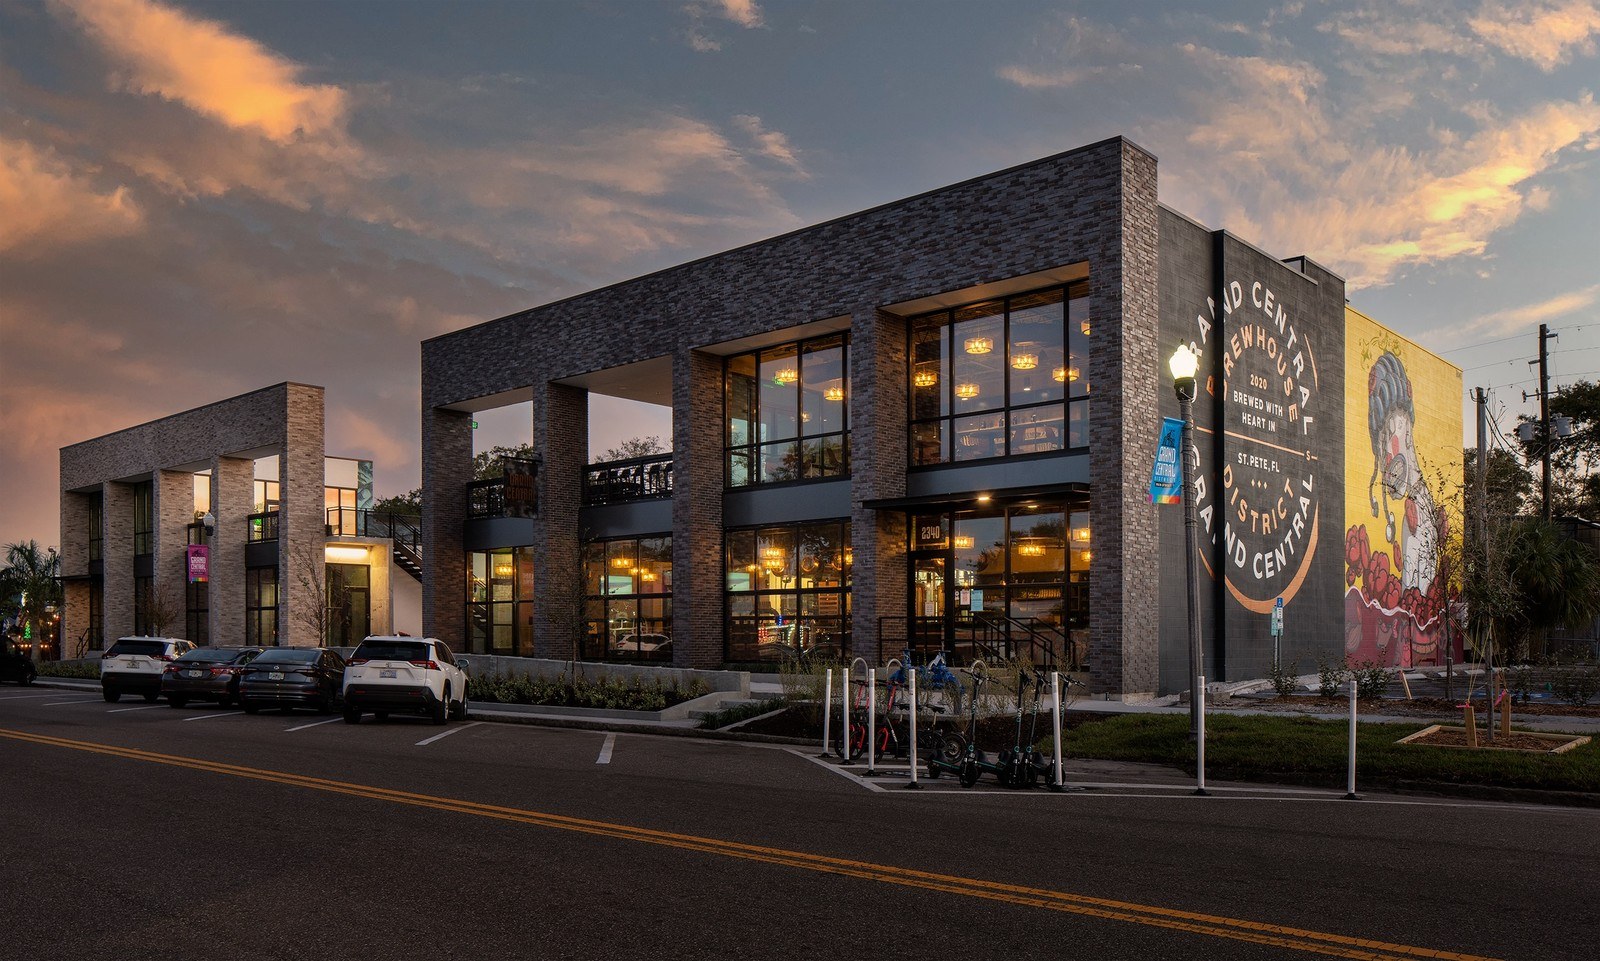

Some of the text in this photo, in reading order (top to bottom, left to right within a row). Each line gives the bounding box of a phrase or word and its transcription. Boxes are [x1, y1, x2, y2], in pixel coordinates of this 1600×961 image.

[1252, 280, 1314, 435] CENTRAL
[1250, 373, 1268, 391] 2020
[1233, 390, 1283, 417] BREWED WITH
[1242, 411, 1276, 432] HEART IN
[1223, 463, 1294, 536] DISTRICT
[921, 525, 940, 540] 2340
[1252, 473, 1314, 580] CENTRAL
